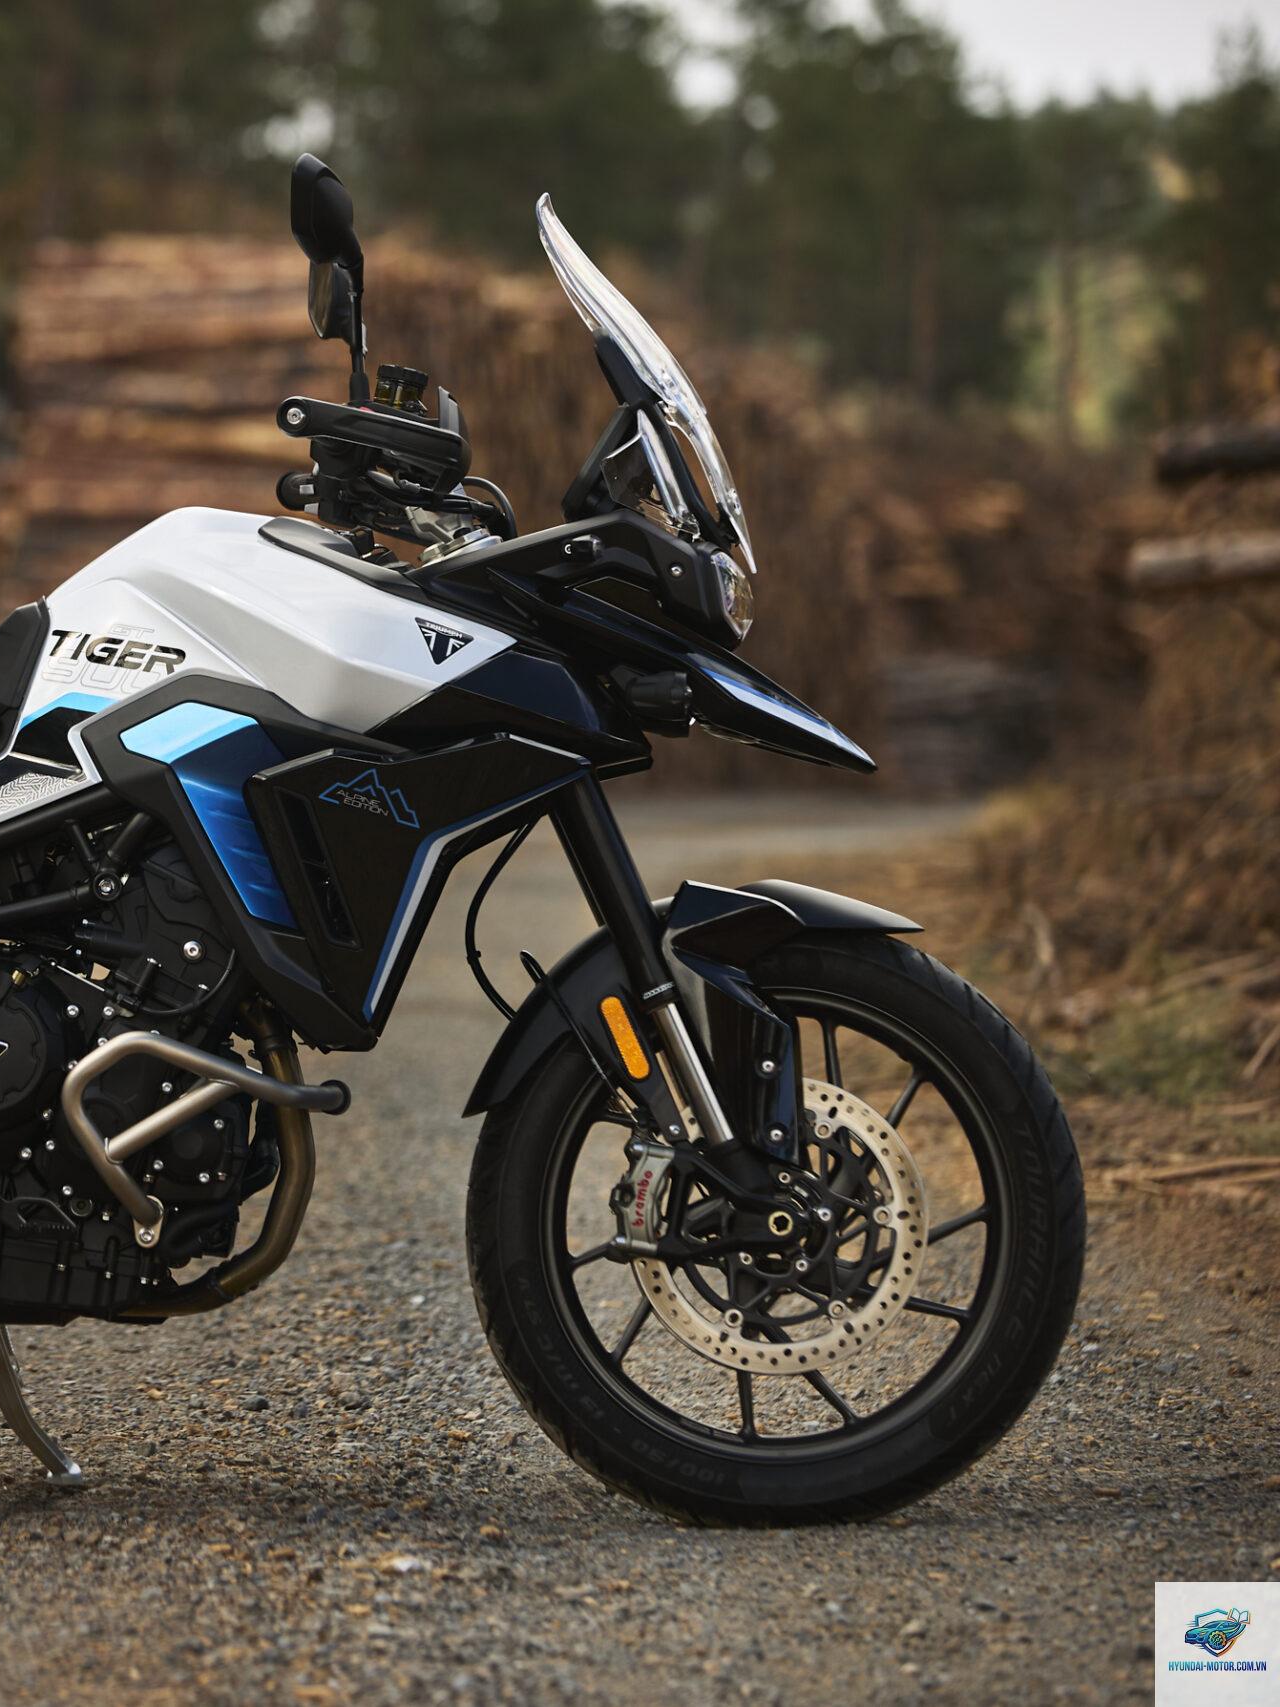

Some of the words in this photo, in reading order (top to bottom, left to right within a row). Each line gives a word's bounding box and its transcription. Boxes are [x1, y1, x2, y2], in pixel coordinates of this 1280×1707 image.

[50, 630, 186, 675] TIGER
[337, 790, 380, 806] ALPINE
[344, 797, 389, 816] EDITION
[632, 1171, 653, 1227] brembo
